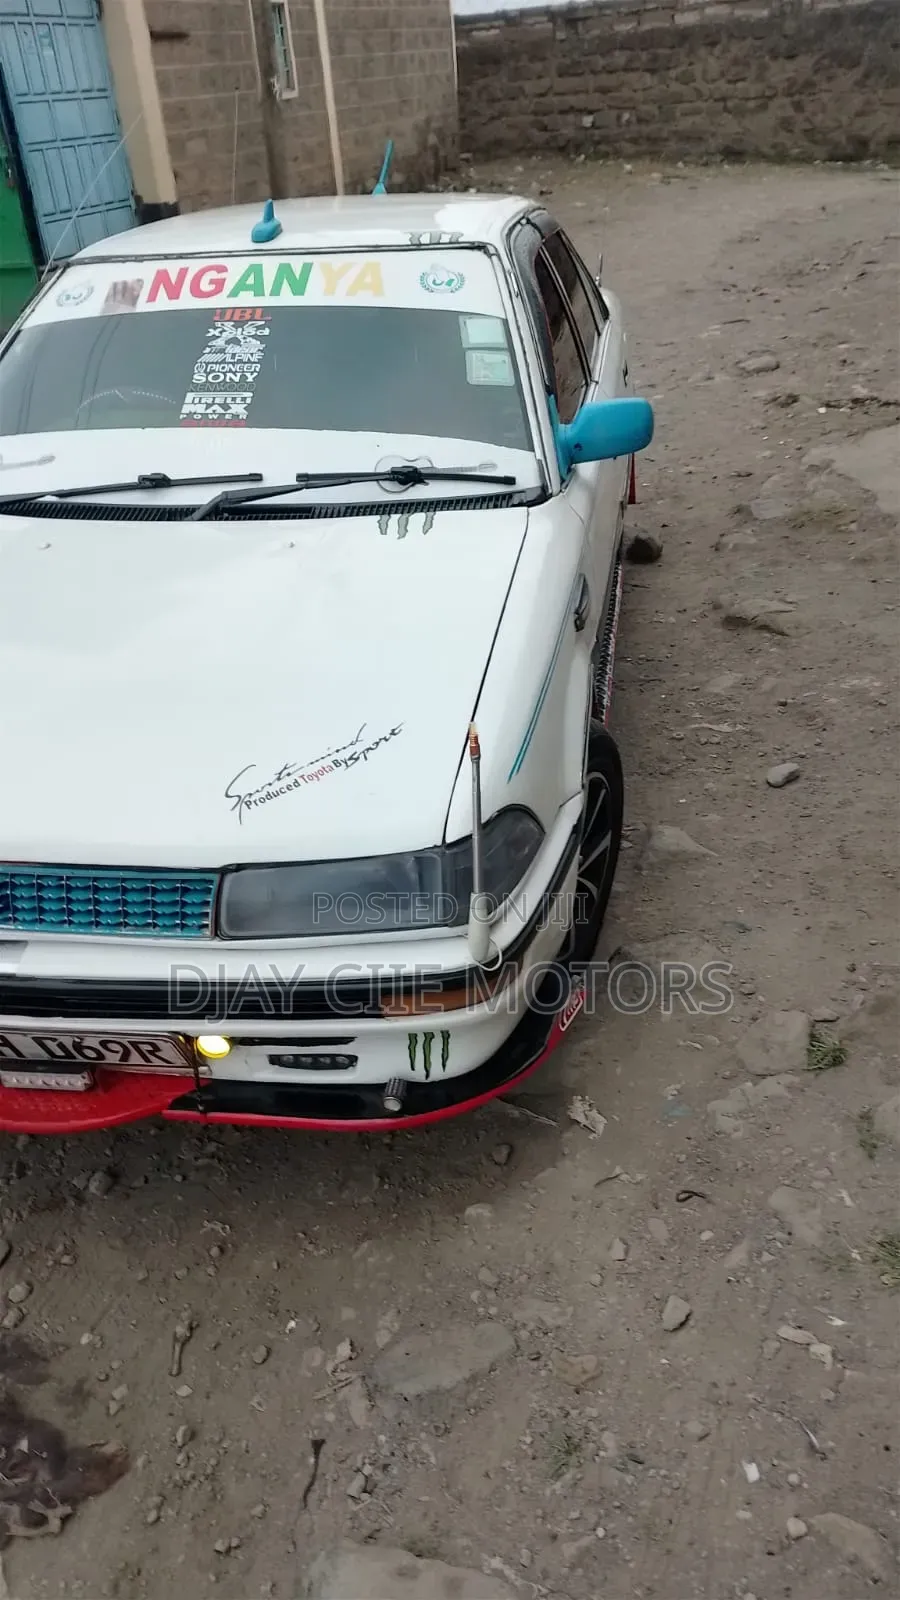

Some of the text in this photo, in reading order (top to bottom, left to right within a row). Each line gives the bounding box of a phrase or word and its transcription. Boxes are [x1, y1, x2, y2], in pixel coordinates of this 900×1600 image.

[146, 261, 385, 303] NGANYA
[206, 363, 261, 372] PIONEER
[192, 372, 258, 383] SONY
[187, 382, 256, 392] KENWOOD
[184, 392, 253, 404] PIRELLI
[181, 403, 248, 415] MAX
[244, 778, 301, 810] Produced
[299, 764, 335, 784] Toyota
[331, 758, 349, 770] By
